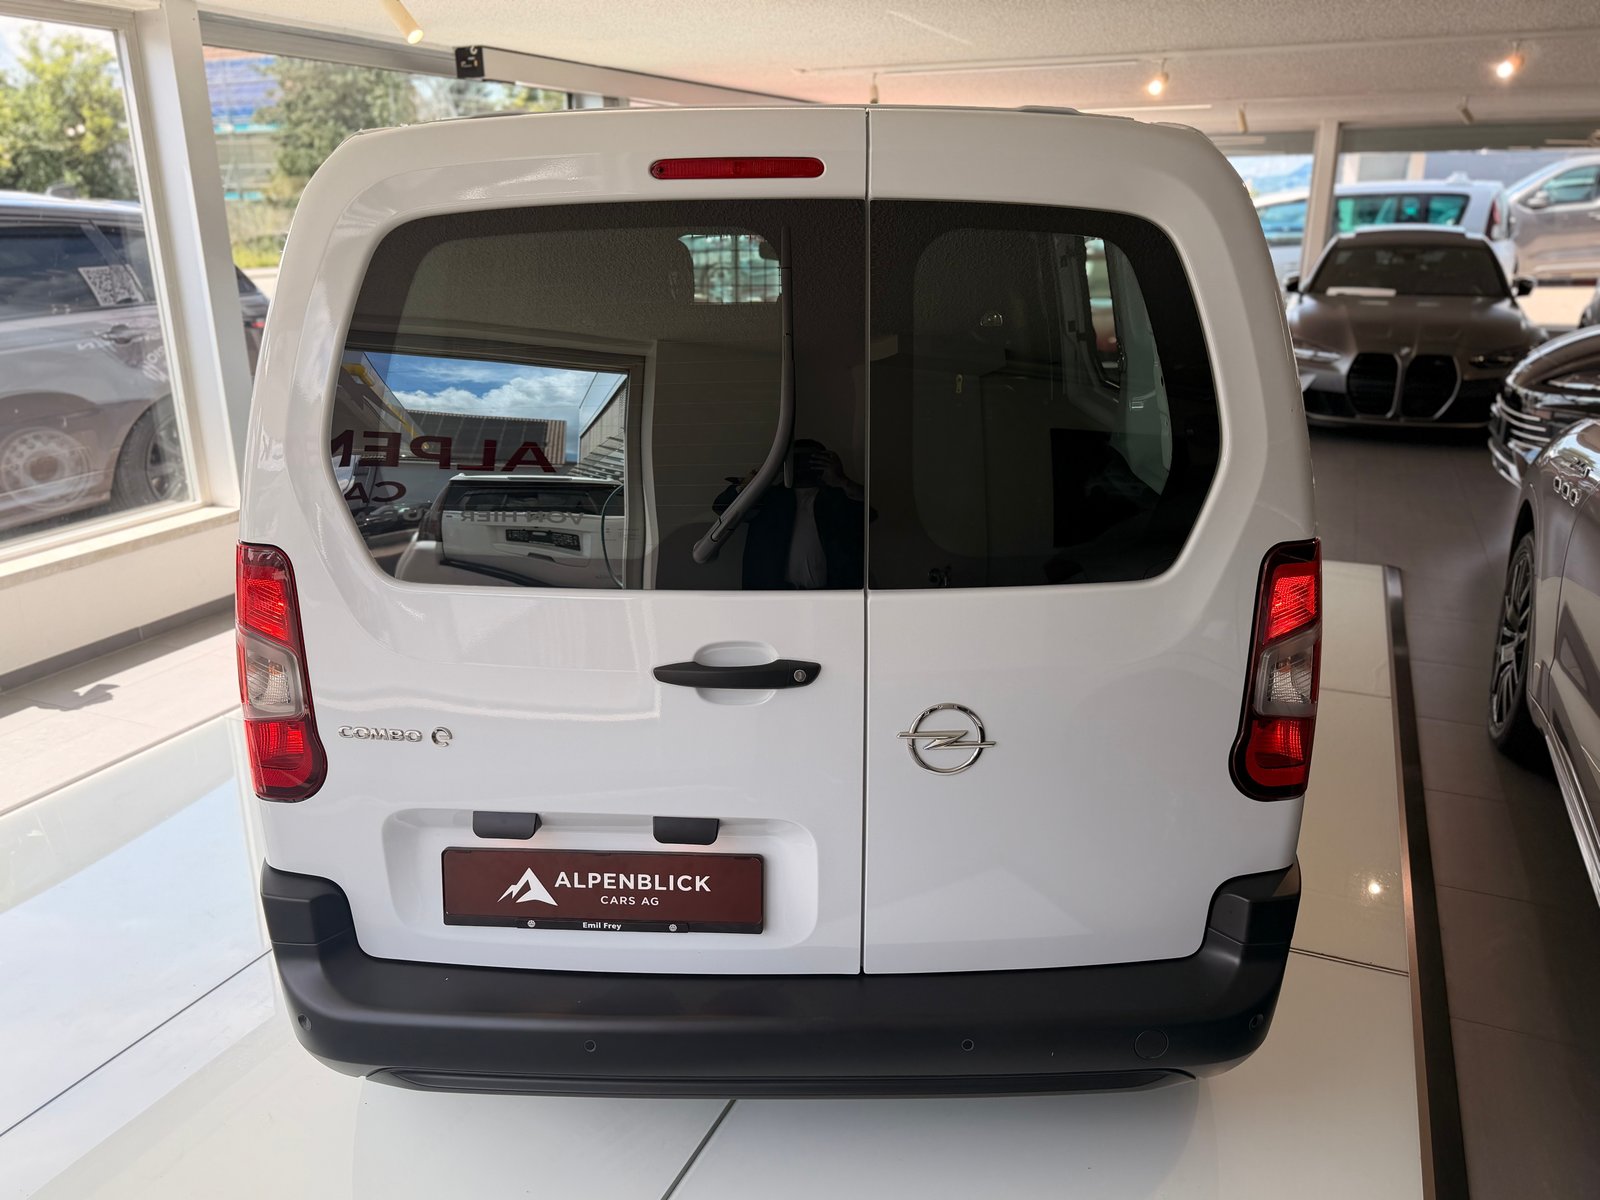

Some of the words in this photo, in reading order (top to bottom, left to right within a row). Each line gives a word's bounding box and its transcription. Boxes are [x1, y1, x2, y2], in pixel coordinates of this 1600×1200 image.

[338, 725, 424, 743] COMBO
[554, 871, 711, 892] ALPENBLICK
[600, 895, 636, 906] CARS
[641, 896, 660, 907] AG
[582, 921, 602, 930] Emil
[603, 922, 622, 932] Frey
